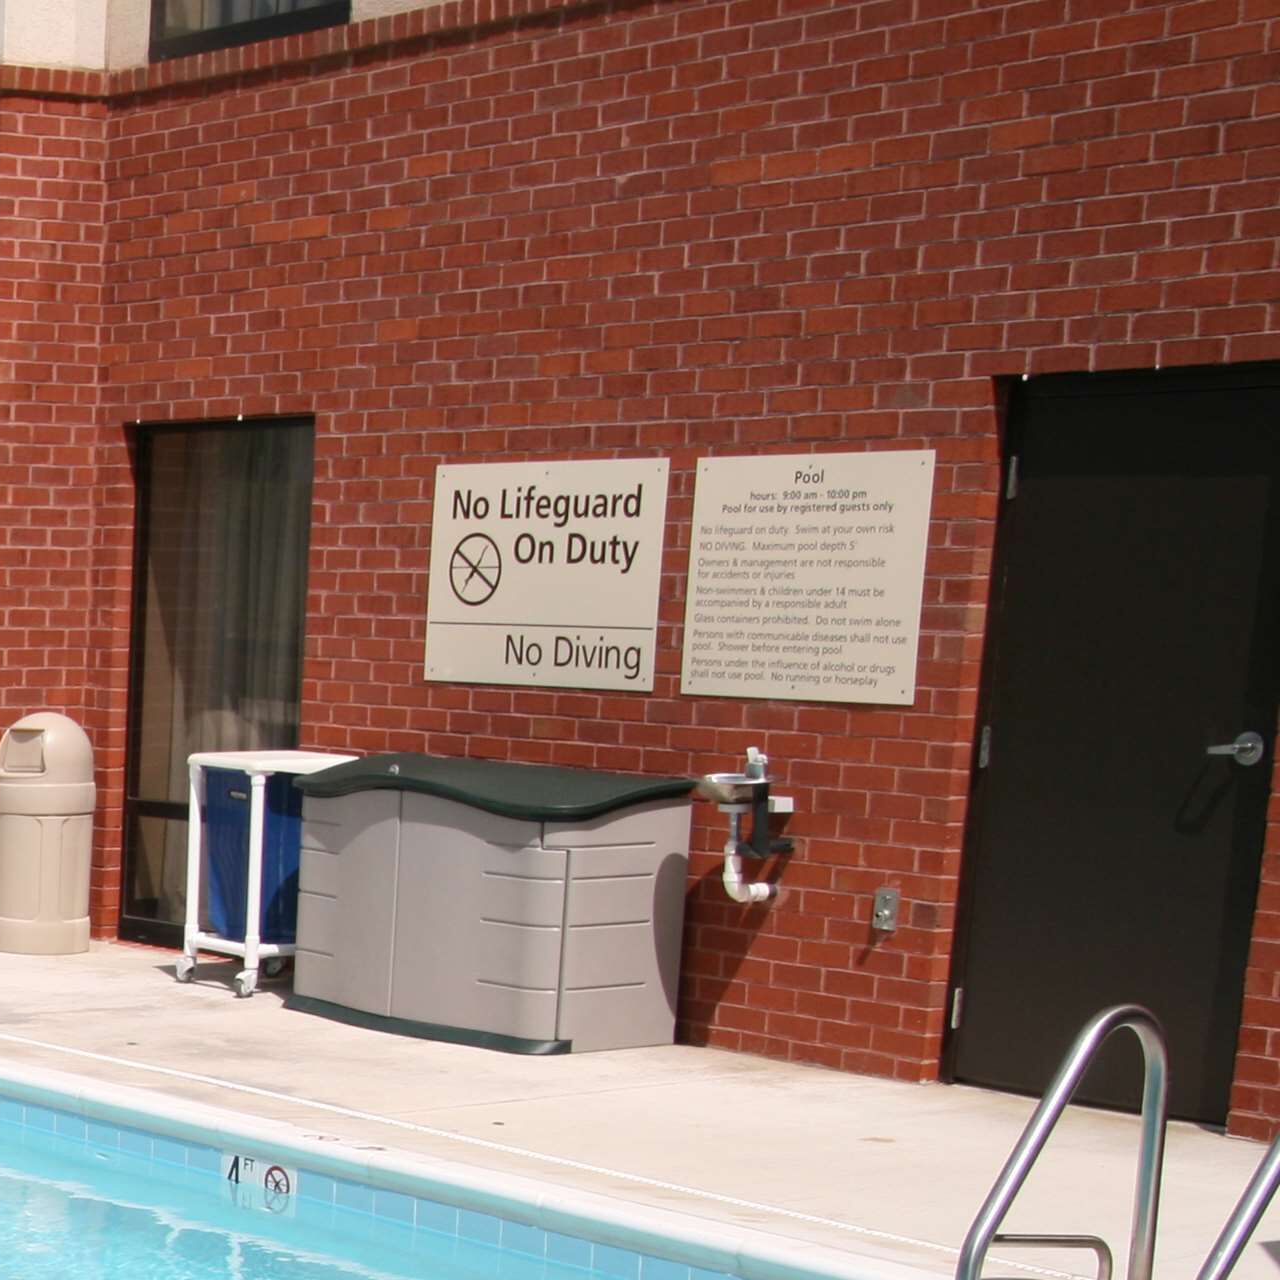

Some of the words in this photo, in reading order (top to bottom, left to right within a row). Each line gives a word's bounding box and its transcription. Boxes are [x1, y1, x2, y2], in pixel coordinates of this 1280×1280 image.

[794, 469, 824, 485] Pool
[750, 491, 777, 501] hours:
[782, 490, 801, 500] 9:00
[804, 492, 818, 500] am
[827, 489, 850, 500] 10:00
[852, 491, 867, 502] pm
[451, 488, 490, 520] No
[500, 482, 643, 528] Lifeguard
[722, 504, 742, 514] Pool
[743, 503, 756, 513] for
[759, 504, 775, 513] use
[776, 503, 787, 515] by
[790, 502, 837, 515] registered
[839, 502, 870, 515] guests
[872, 501, 894, 513] only
[701, 526, 712, 535] No
[714, 525, 753, 537] lifeguard
[755, 527, 767, 535] on
[795, 524, 819, 535] Swim
[821, 525, 831, 535] at
[833, 526, 853, 537] your
[855, 526, 876, 534] own
[878, 524, 895, 534] risk
[513, 531, 555, 565] On
[565, 533, 640, 574] Duty
[700, 542, 713, 551] NO
[752, 542, 796, 551] Maximum
[798, 541, 817, 552] pool
[820, 541, 847, 552] depth
[698, 558, 730, 567] Owners
[732, 557, 738, 567] &
[740, 559, 797, 570] management
[799, 559, 815, 568] are
[816, 558, 832, 568] not
[834, 557, 886, 569] responsible
[698, 569, 709, 578] for
[711, 569, 750, 579] accidents
[751, 571, 761, 579] or
[763, 570, 795, 582] injuries
[696, 586, 757, 596] Non-swimmers
[760, 586, 766, 596] &
[767, 586, 803, 596] children
[806, 587, 832, 597] under
[835, 587, 846, 597] 14
[848, 588, 871, 598] must
[873, 587, 885, 597] be
[696, 599, 750, 609] accompanied
[752, 599, 763, 609] by
[772, 599, 821, 609] responsible
[823, 599, 847, 609] adult
[694, 613, 715, 624] Glass
[716, 614, 760, 624] containers
[816, 615, 829, 625] Do
[831, 616, 847, 626] not
[849, 616, 873, 627] swim
[875, 616, 902, 627] alone
[693, 628, 724, 639] Persons
[726, 630, 745, 640] with
[747, 631, 809, 642] communicable
[811, 632, 847, 643] diseases
[849, 633, 871, 643] shall
[872, 634, 889, 644] not
[891, 636, 907, 645] use
[718, 641, 750, 652] Shower
[751, 643, 780, 653] before
[782, 644, 820, 656] entering
[821, 645, 842, 656] pool
[504, 633, 543, 667] No
[553, 634, 642, 680] Diving
[690, 657, 722, 667] Persons
[724, 658, 749, 668] under
[751, 659, 766, 668] the
[767, 659, 809, 669] influence
[810, 661, 820, 670] of
[822, 661, 855, 672] alcohol
[857, 664, 866, 672] or
[869, 663, 896, 676] drugs
[690, 669, 709, 679] shall
[711, 670, 726, 679] not
[728, 671, 742, 679] use
[771, 672, 783, 681] No
[785, 672, 820, 685] running
[822, 675, 833, 684] or
[835, 674, 878, 688] horseplay
[243, 1158, 255, 1172] FT
